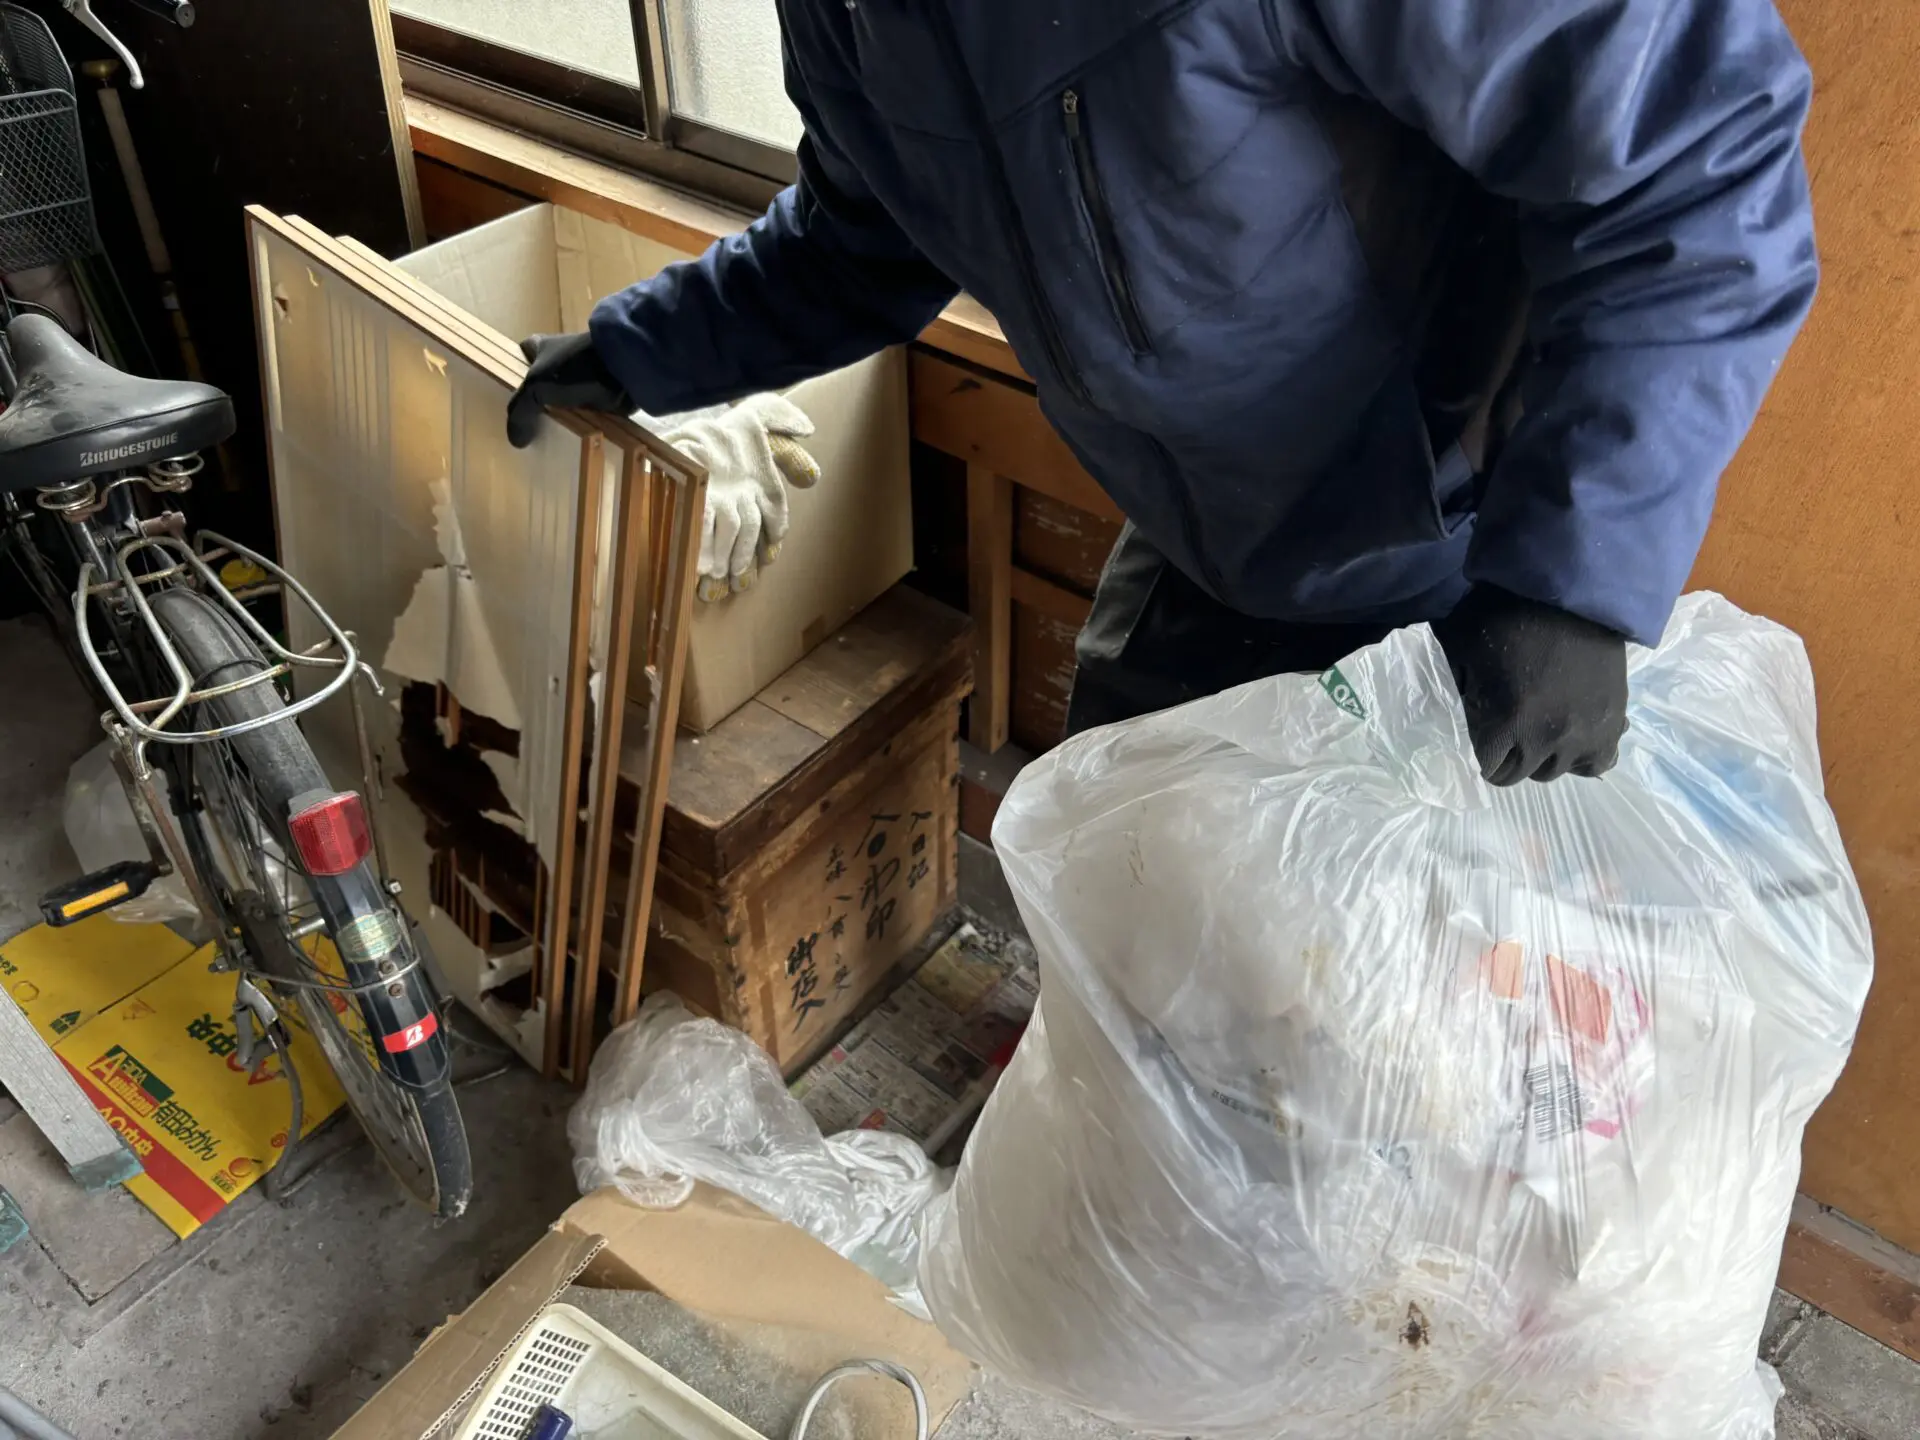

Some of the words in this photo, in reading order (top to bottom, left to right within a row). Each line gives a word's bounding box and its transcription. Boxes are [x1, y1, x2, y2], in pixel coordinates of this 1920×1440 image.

[80, 432, 178, 467] BRIDGESTONE
[150, 1100, 221, 1162] 有田みかん
